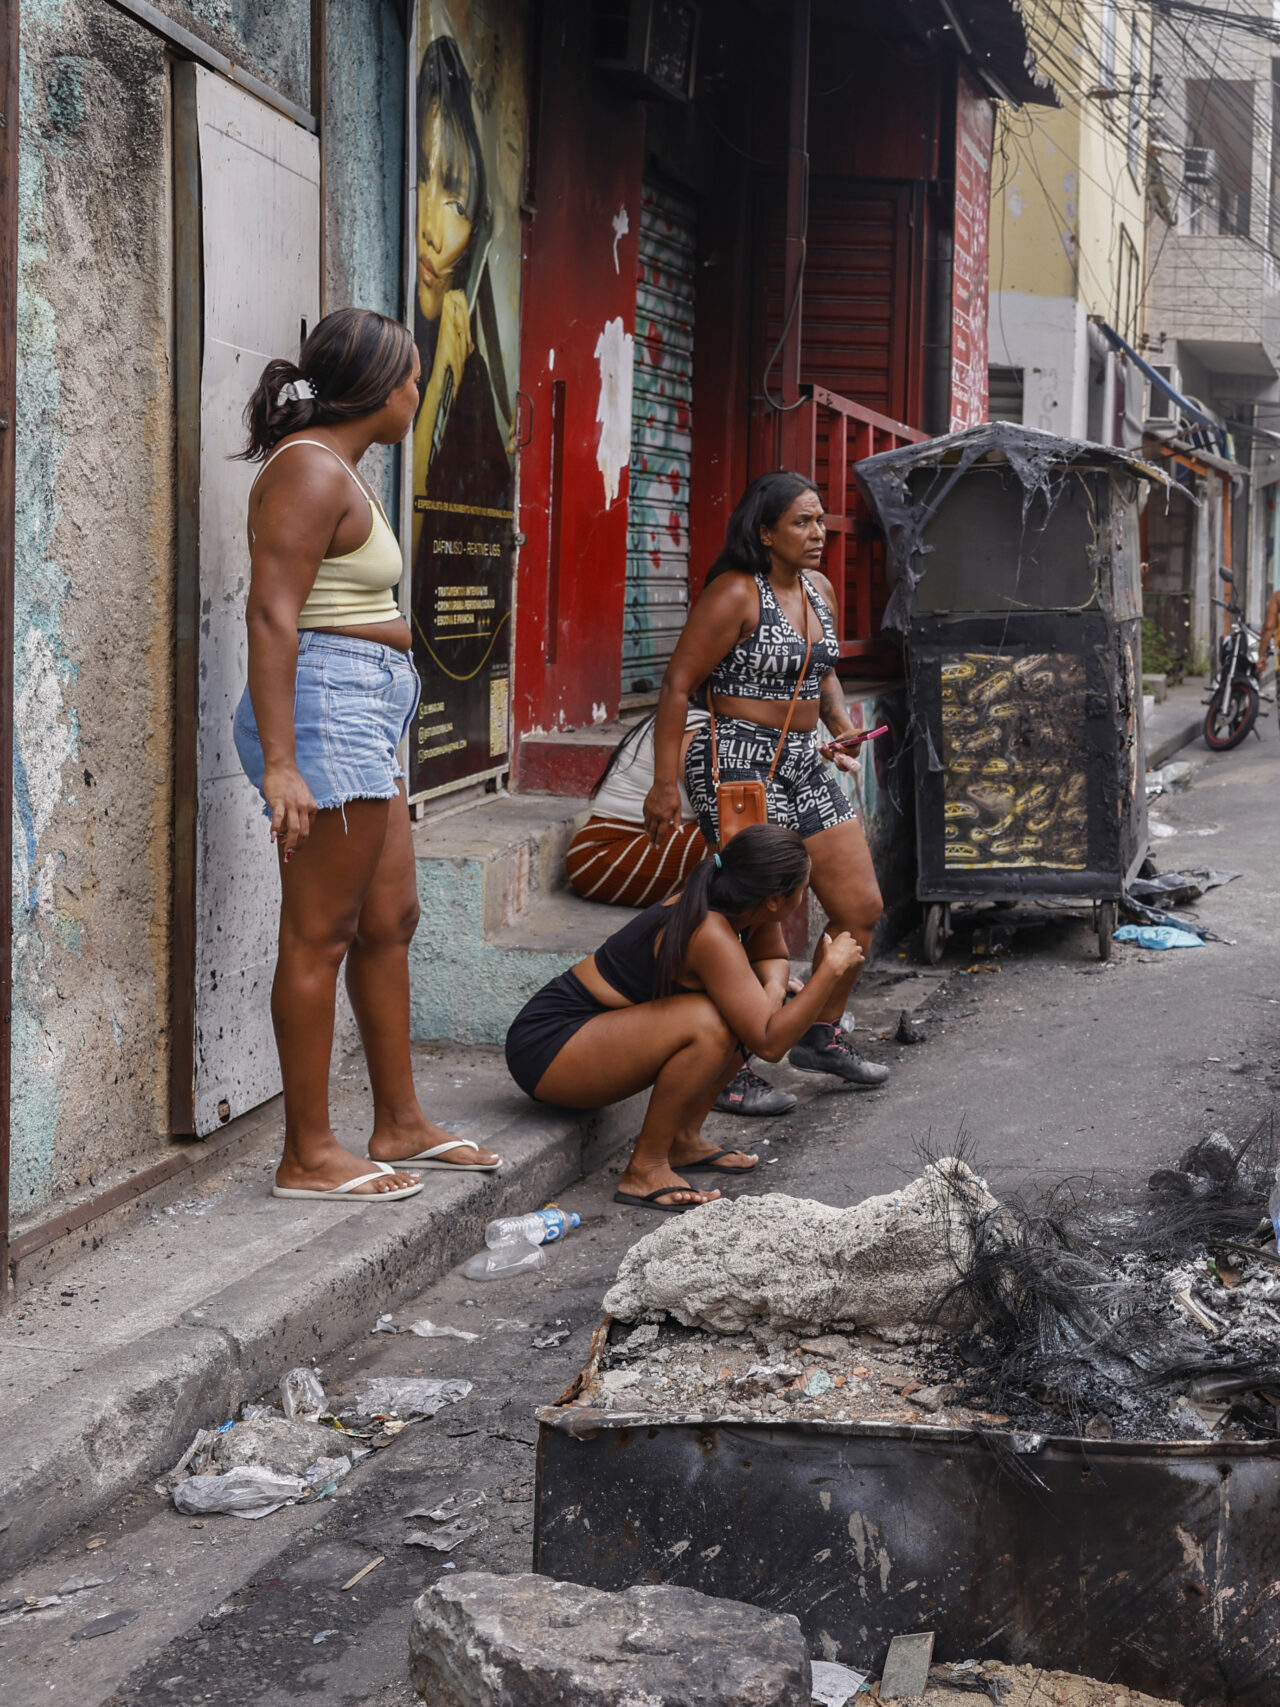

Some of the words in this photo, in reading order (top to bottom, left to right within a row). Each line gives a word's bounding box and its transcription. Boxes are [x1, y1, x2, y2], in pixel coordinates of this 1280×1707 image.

[755, 643, 789, 656] LIVES
[728, 739, 777, 763] LIVES
[718, 757, 751, 769] LIVES
